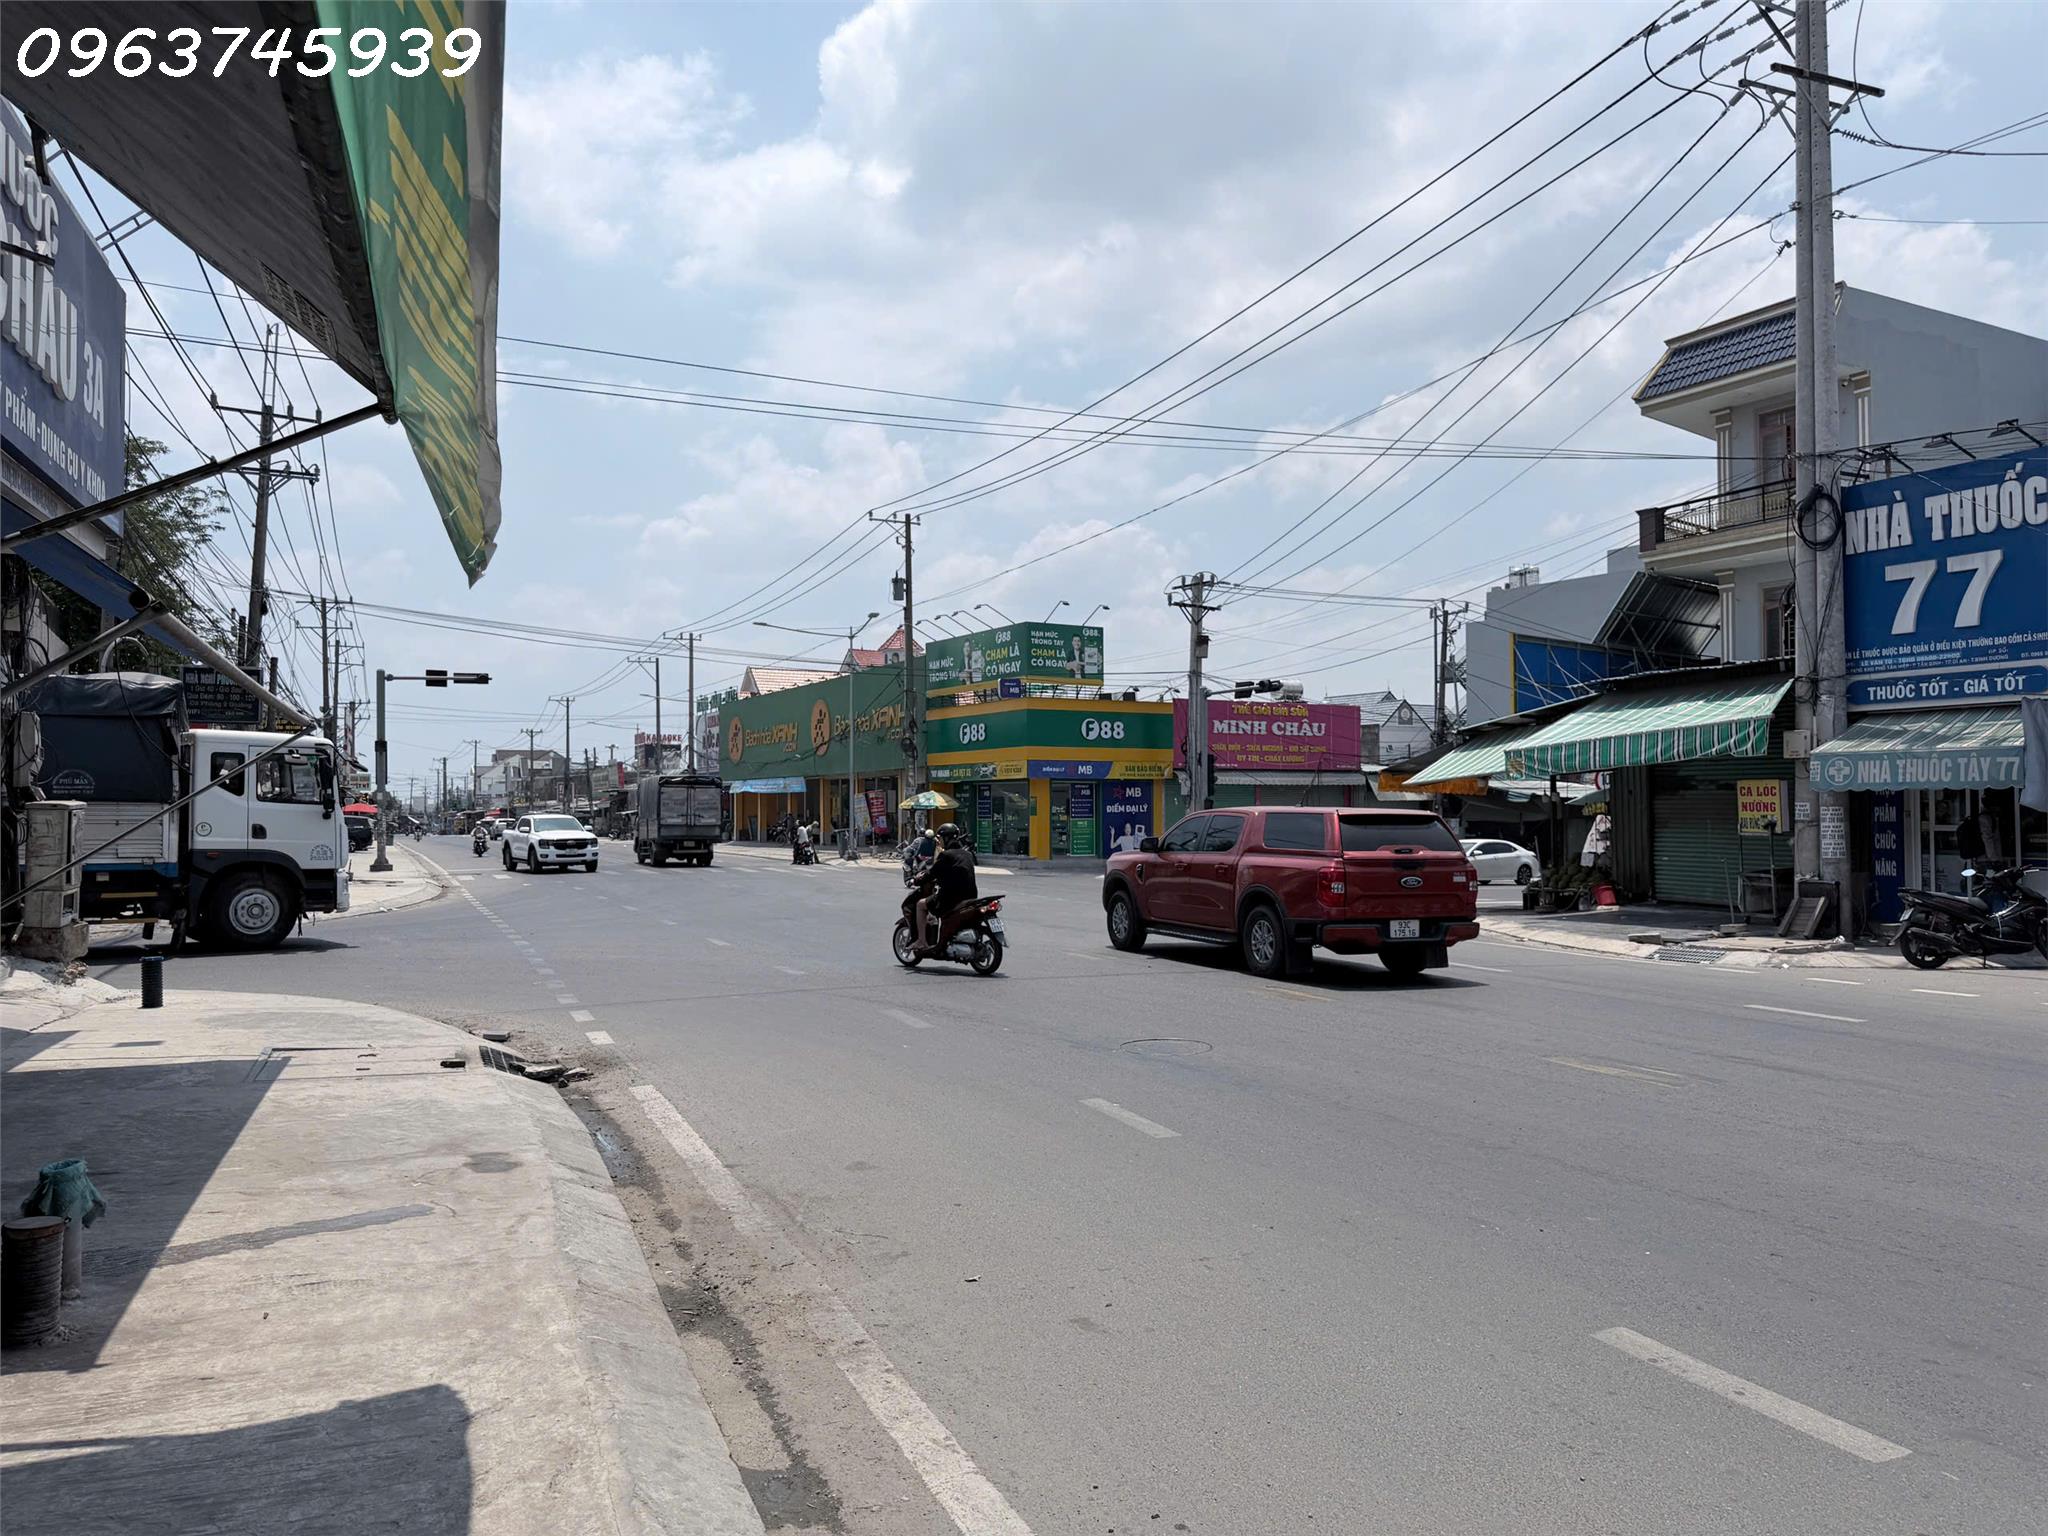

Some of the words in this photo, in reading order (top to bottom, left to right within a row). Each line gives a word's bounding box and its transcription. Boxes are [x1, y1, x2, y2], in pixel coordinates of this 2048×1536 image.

[83, 341, 104, 429] 3A
[5, 386, 36, 441] PHẨM
[41, 421, 66, 471] DỤNG
[67, 448, 79, 487] CỤ
[79, 456, 86, 487] Y
[1845, 490, 1913, 555] NHÀ
[1924, 463, 2048, 541] THUỐC
[1884, 549, 2004, 635] 77
[1994, 634, 2007, 645] BAO
[985, 647, 1008, 663] CHẠM
[1046, 660, 1067, 668] NGAY
[999, 660, 1021, 673] NGAY
[1867, 676, 1916, 701] THUỐC
[1919, 675, 1949, 697] TỐT
[1963, 674, 1989, 694] GIÁ
[1994, 670, 2027, 692] TỐT
[959, 723, 986, 745] F88
[1081, 717, 1125, 741] F88
[1213, 720, 1267, 735] MINH
[1271, 719, 1326, 737] CHÂU
[1078, 765, 1093, 774] MB
[1857, 755, 1891, 784] NHÀ
[1958, 752, 1991, 782] TÂY
[1996, 756, 2020, 781] 77
[1126, 787, 1142, 797] MB
[1106, 803, 1125, 813] ĐIỂM
[1126, 804, 1139, 814] ĐẠI
[1875, 858, 1897, 877] NĂNG
